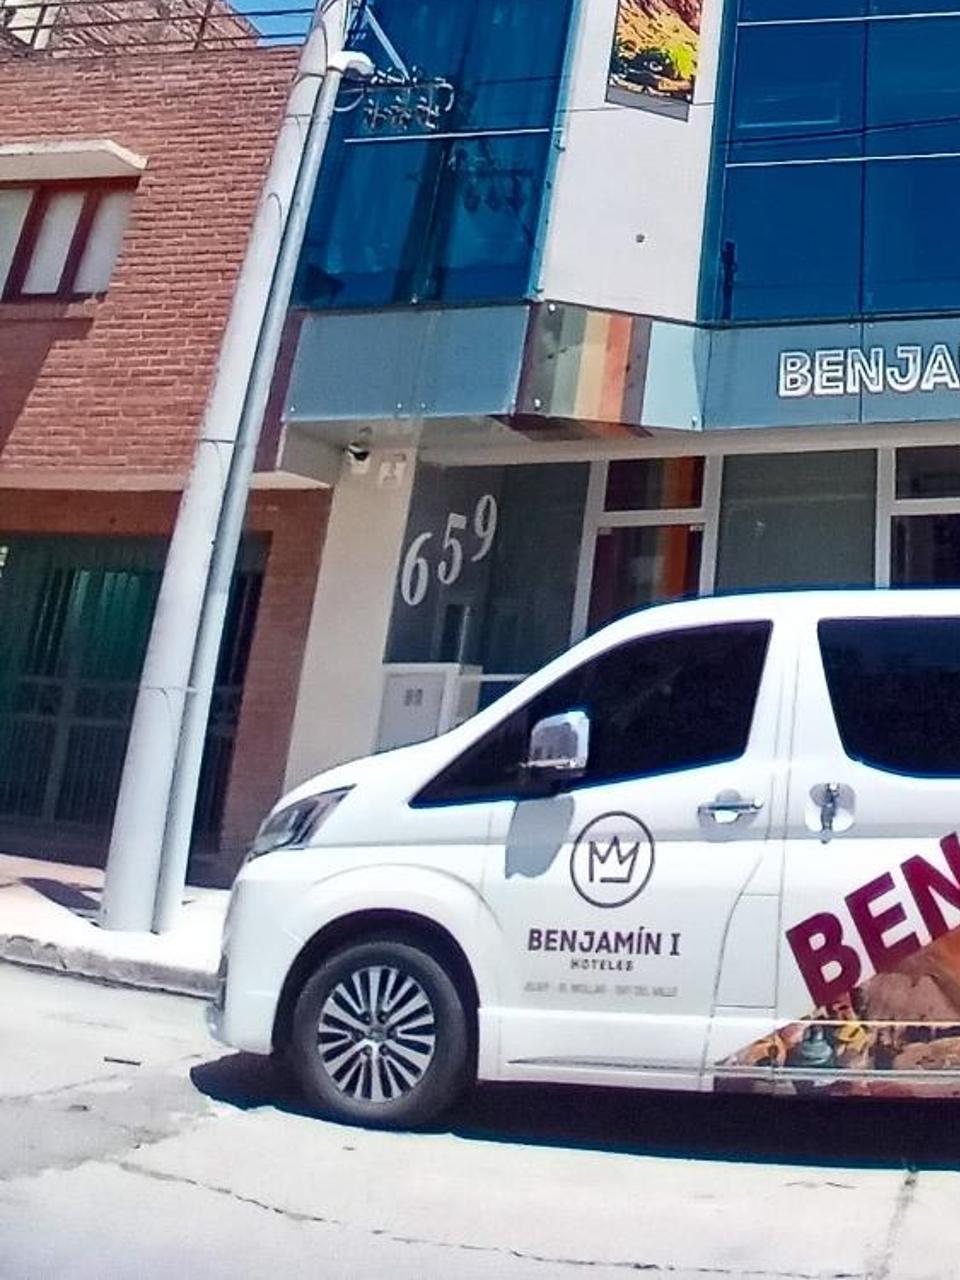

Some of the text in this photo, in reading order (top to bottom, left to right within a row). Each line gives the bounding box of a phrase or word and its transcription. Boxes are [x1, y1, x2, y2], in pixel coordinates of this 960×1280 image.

[401, 494, 497, 606] 659
[527, 926, 681, 956] BENJAMÍN I
[570, 958, 634, 972] HOTELES
